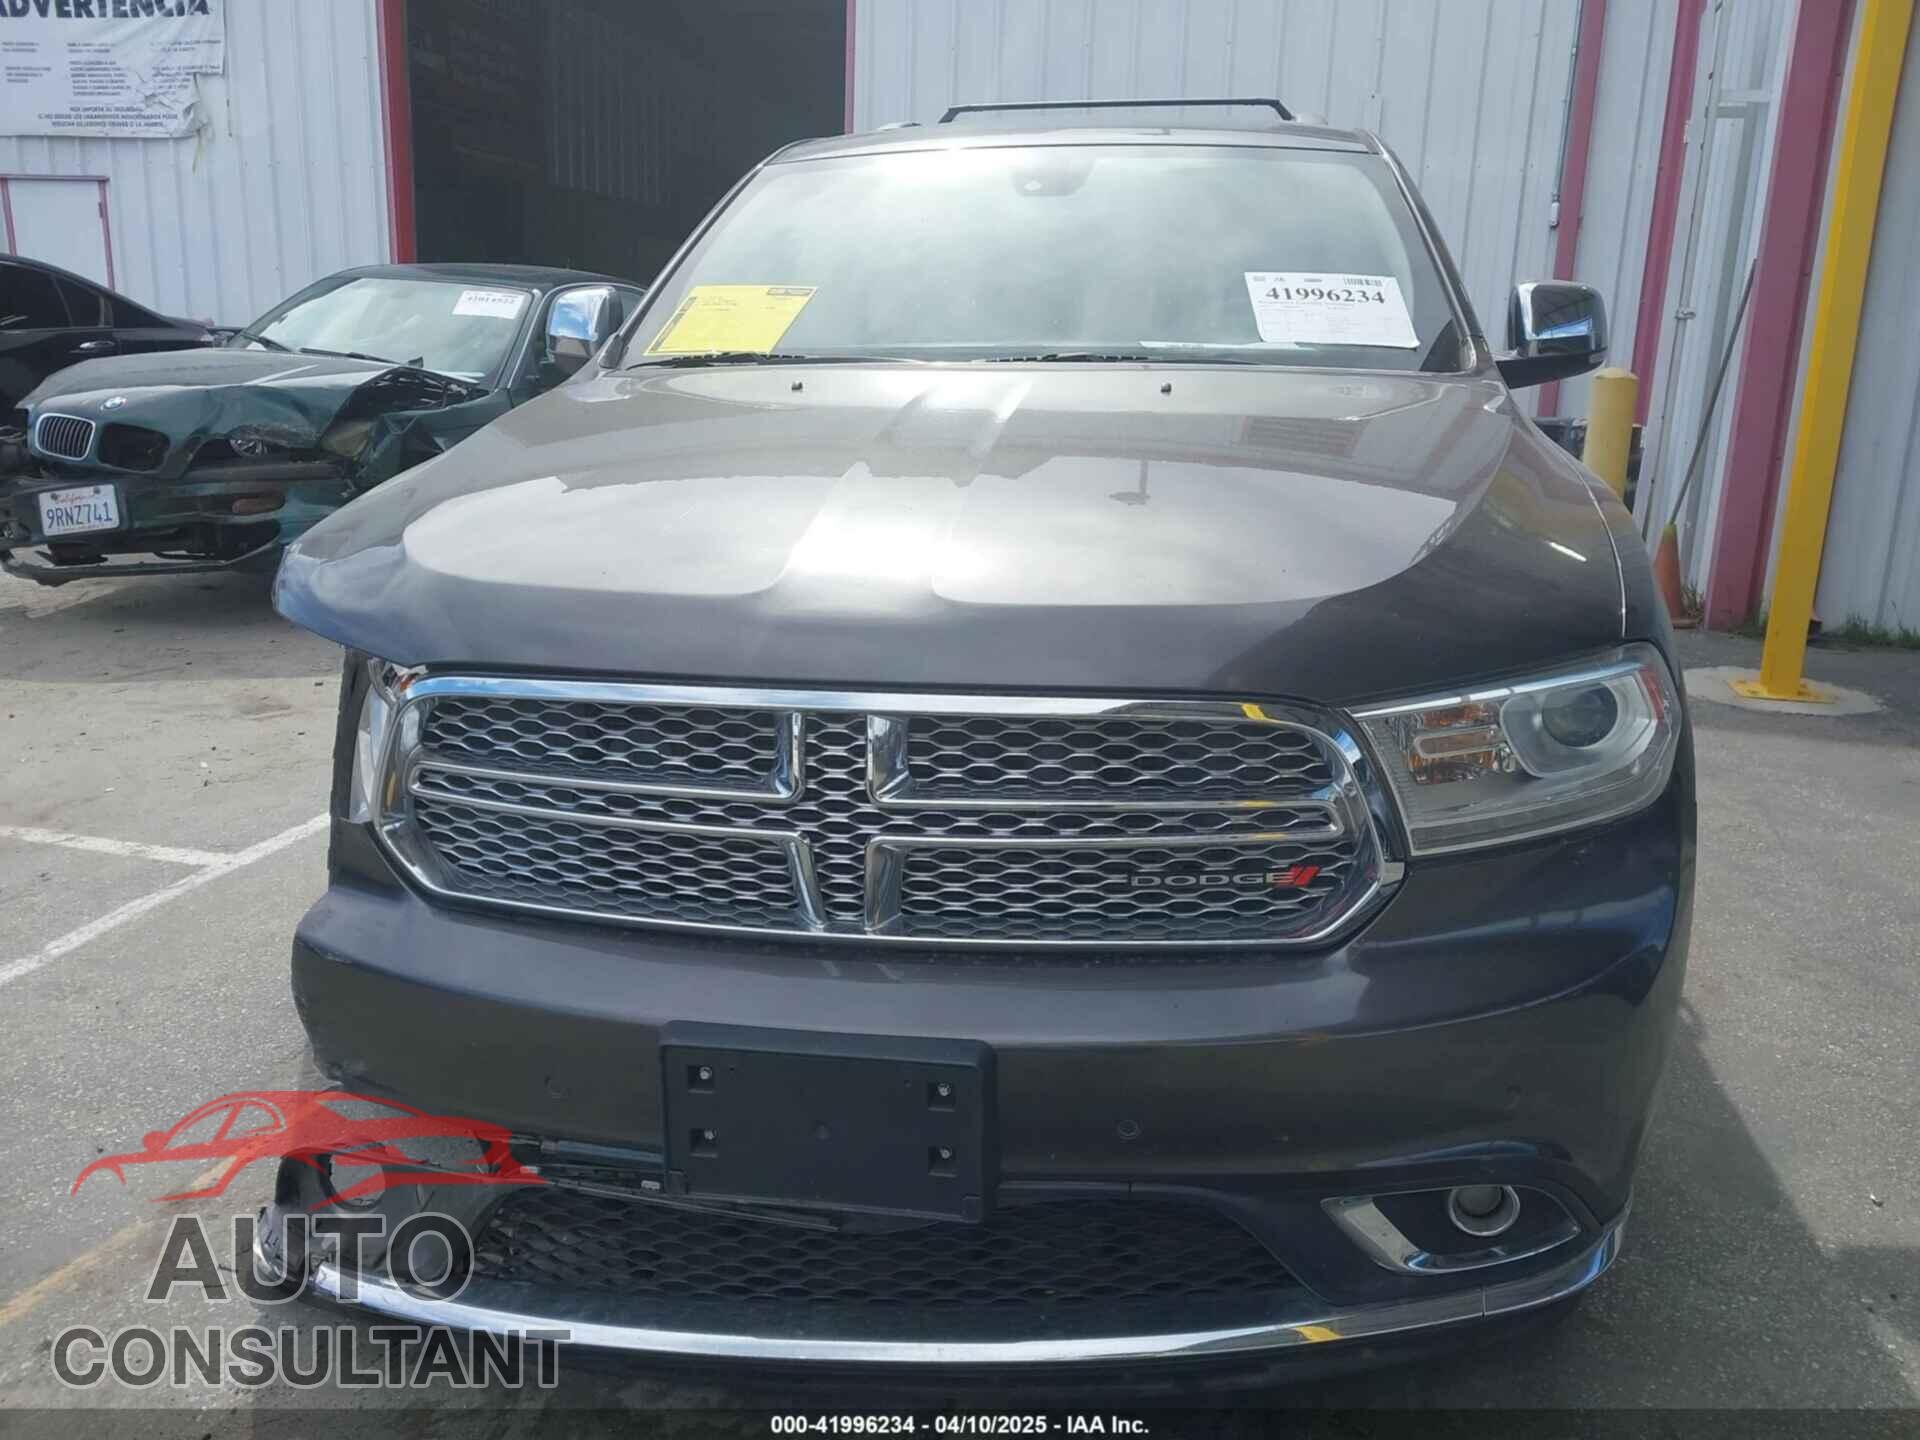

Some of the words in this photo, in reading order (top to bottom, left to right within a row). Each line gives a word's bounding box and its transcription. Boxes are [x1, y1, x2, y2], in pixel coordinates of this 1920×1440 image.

[1265, 287, 1385, 304] 41996234
[46, 501, 113, 528] 9RNZ741
[1131, 872, 1294, 887] DODGE
